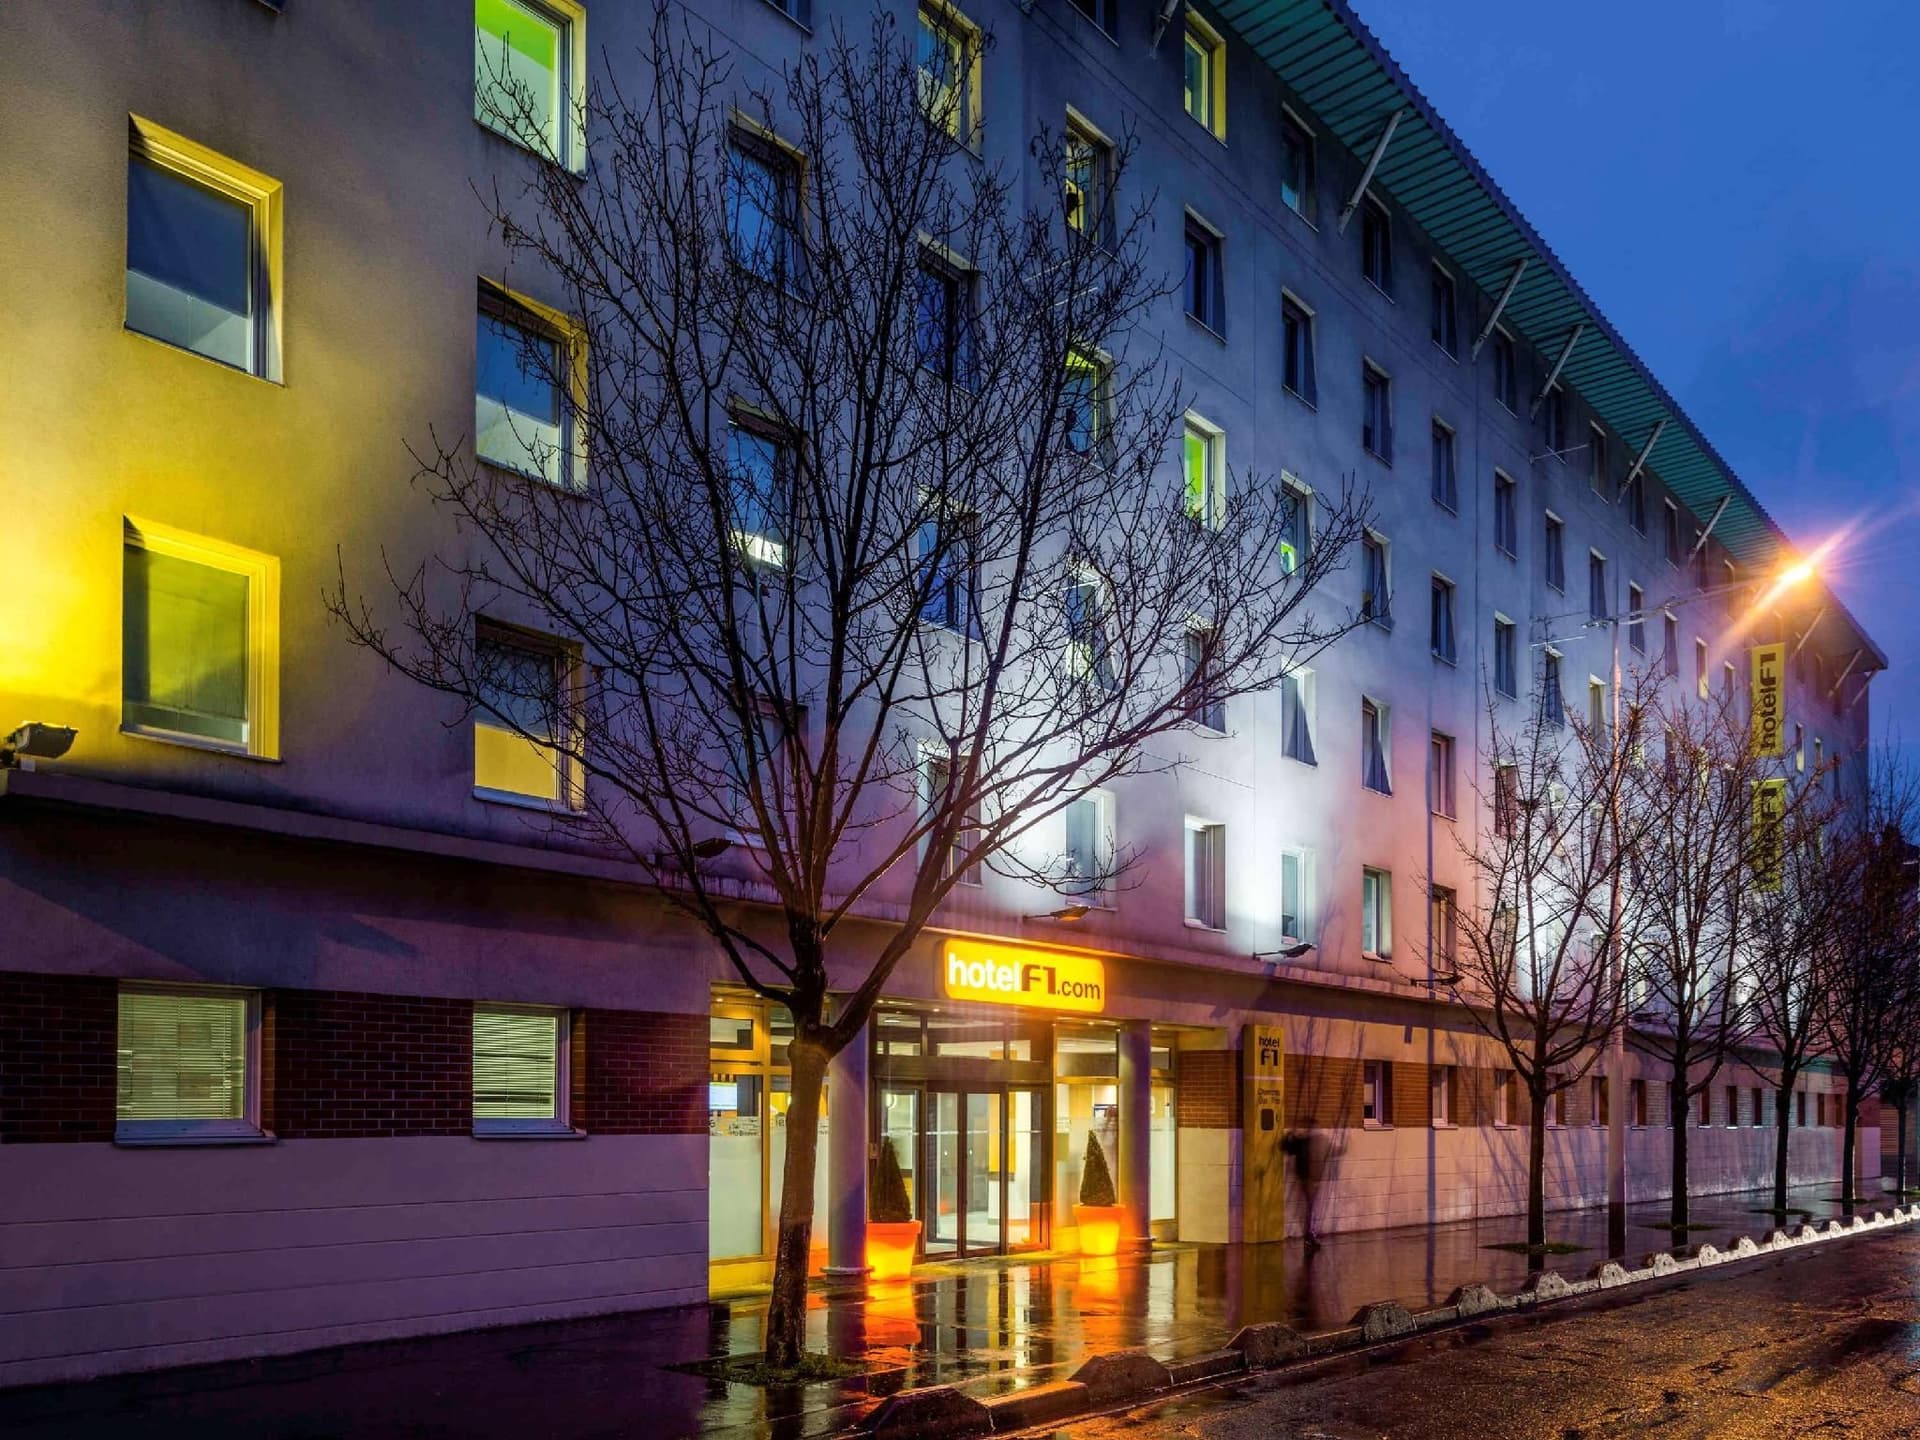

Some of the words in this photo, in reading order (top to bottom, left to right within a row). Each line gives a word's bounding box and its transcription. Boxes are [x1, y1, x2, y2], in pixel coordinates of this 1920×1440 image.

[1759, 652, 1777, 750] hotelF1
[1258, 1036, 1280, 1048] hotel
[1260, 1049, 1279, 1066] F1
